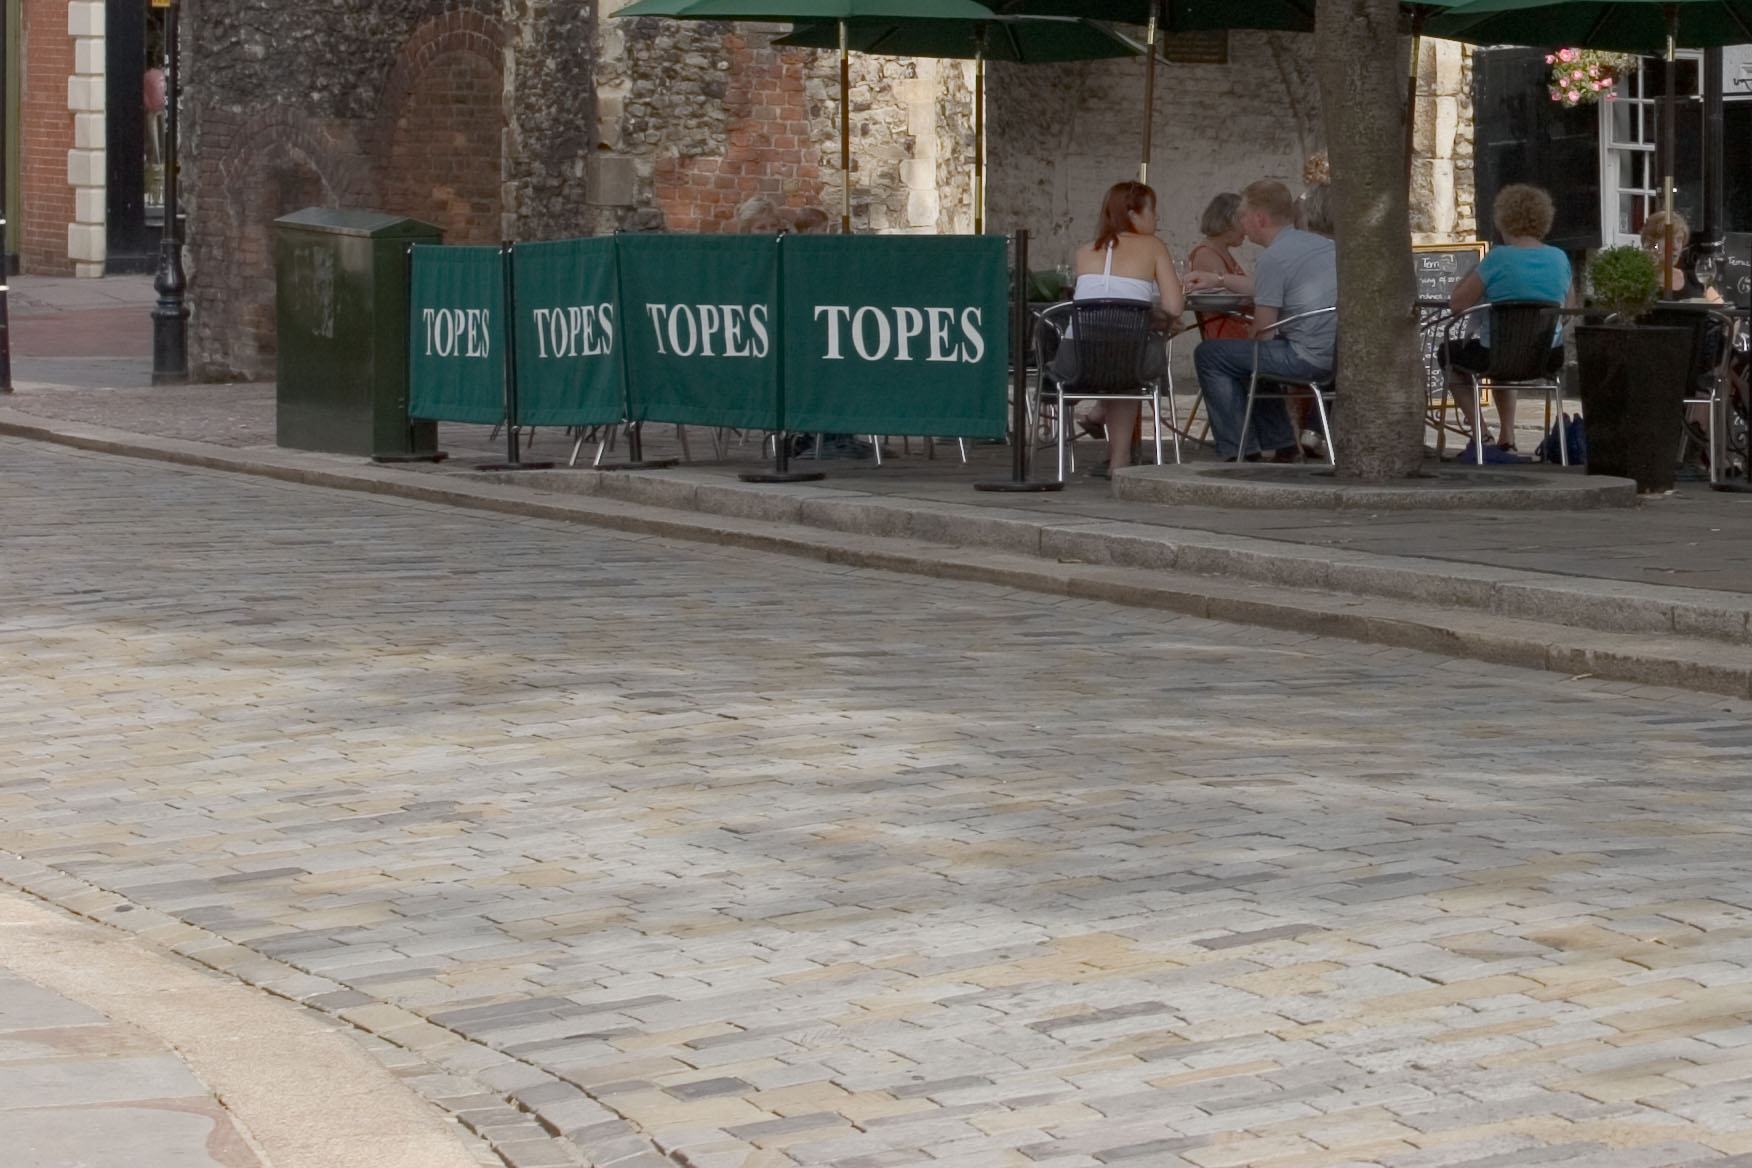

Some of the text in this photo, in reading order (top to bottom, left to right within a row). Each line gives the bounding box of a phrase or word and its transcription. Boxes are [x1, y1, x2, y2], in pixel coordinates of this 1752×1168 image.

[423, 308, 490, 359] TOPES
[533, 302, 614, 358] TOPES
[646, 303, 769, 358] TOPES
[814, 305, 985, 364] TOPES
